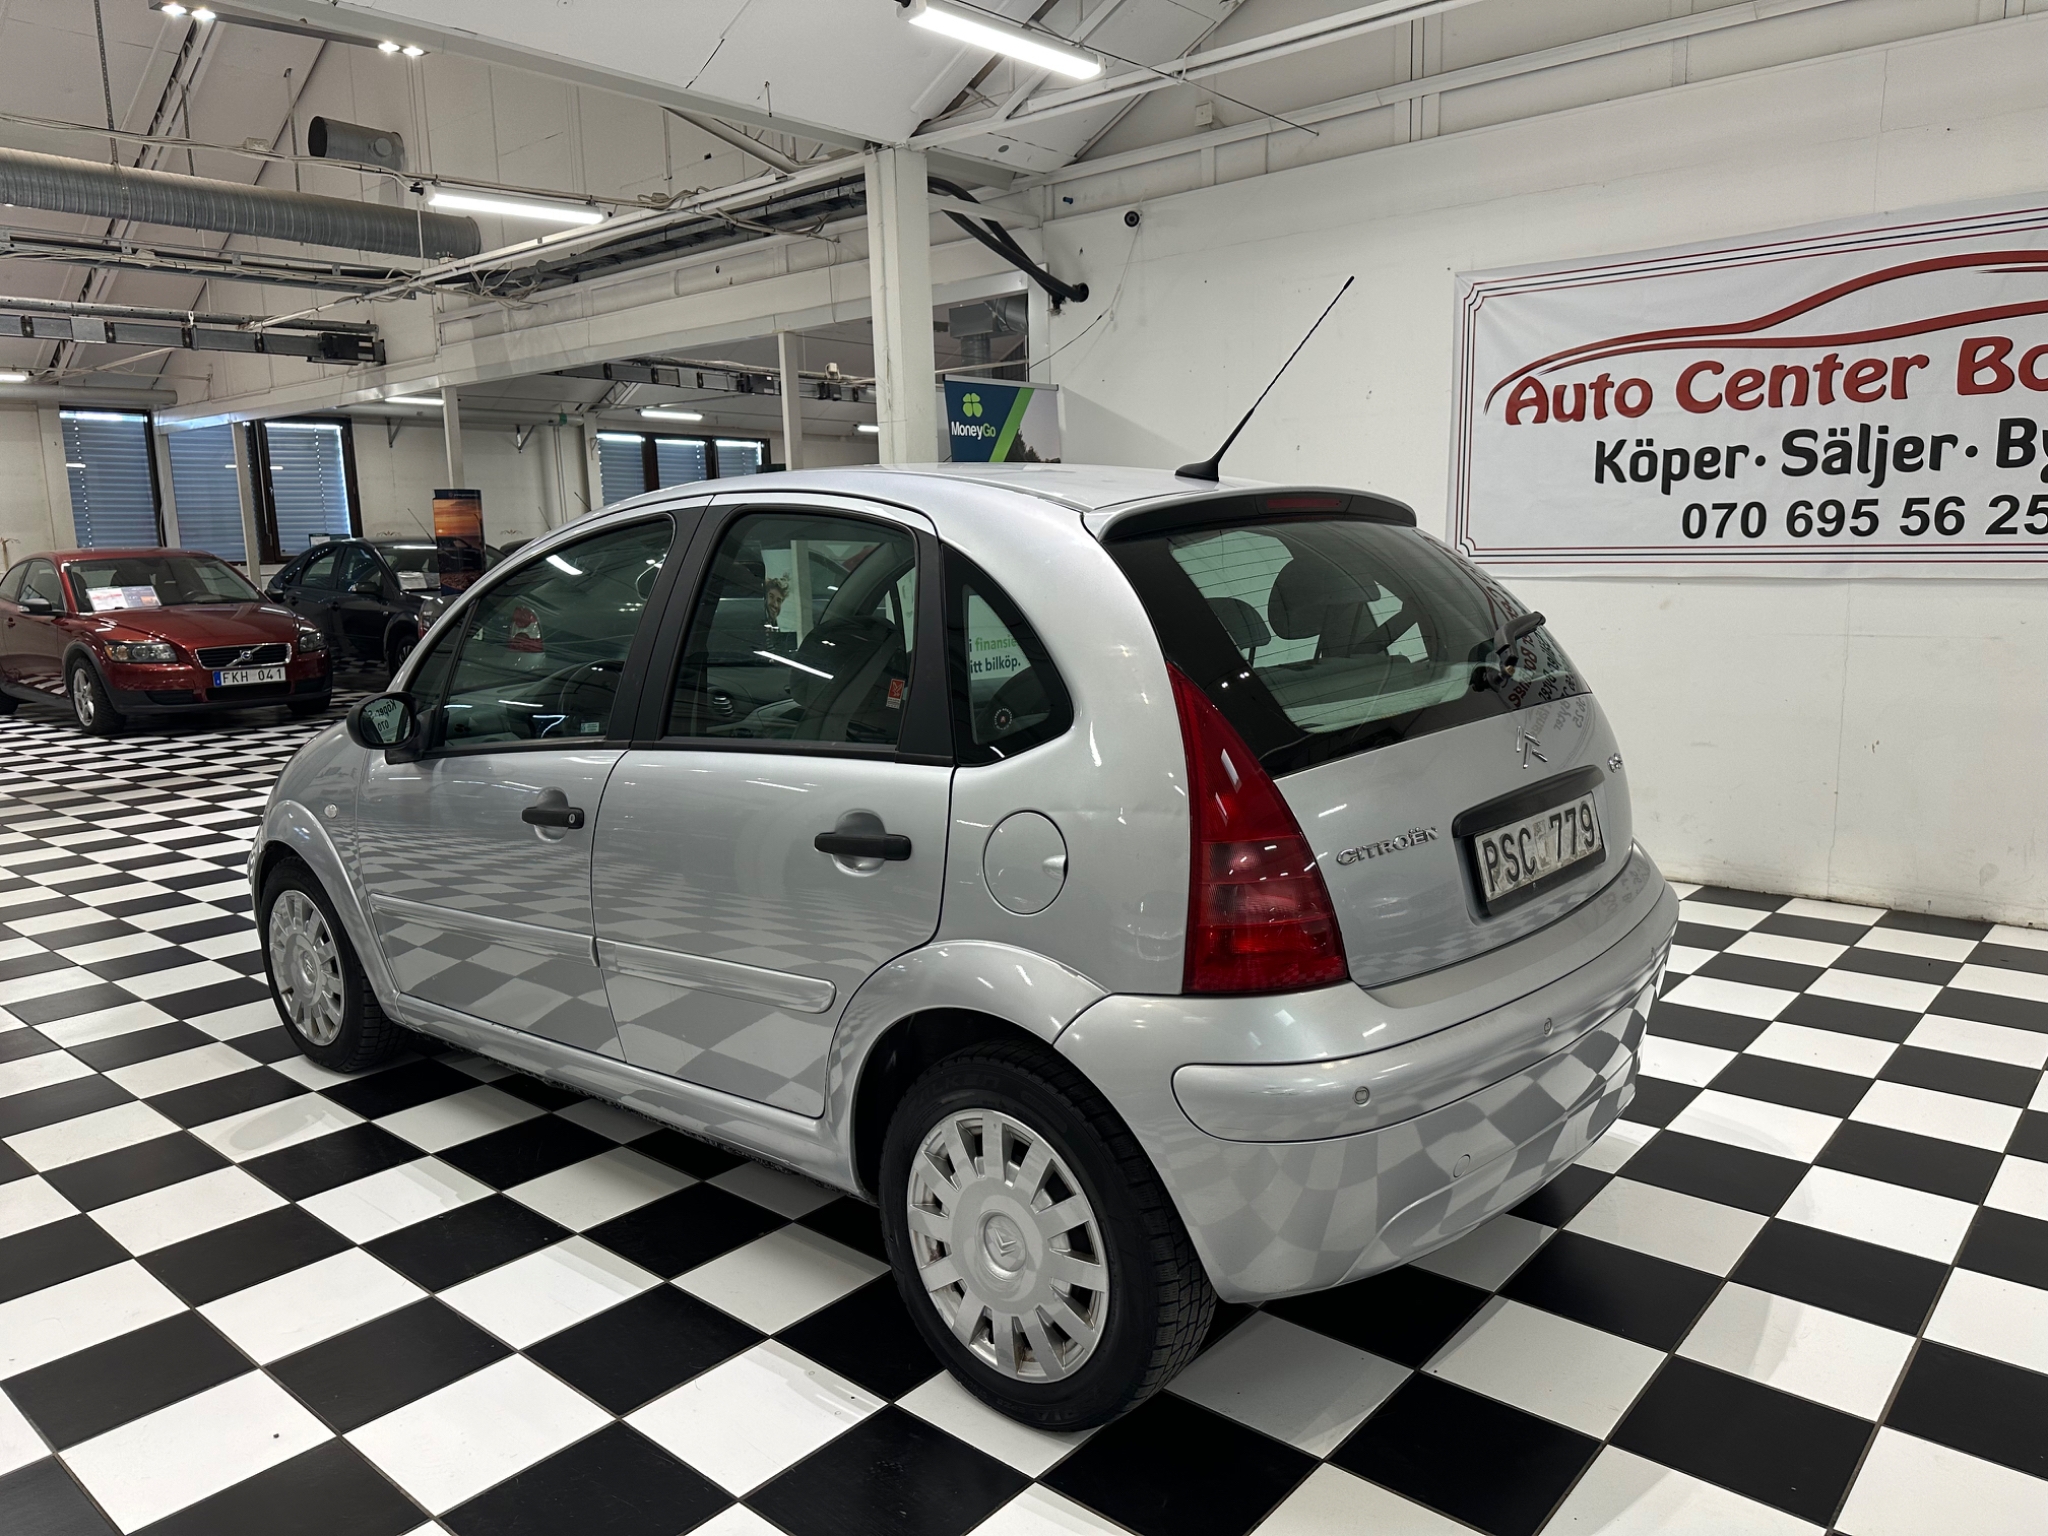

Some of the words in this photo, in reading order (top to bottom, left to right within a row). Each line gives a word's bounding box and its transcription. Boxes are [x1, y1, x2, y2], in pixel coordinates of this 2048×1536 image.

[1505, 373, 1653, 425] Auto
[1675, 353, 1930, 414] Center
[951, 421, 996, 440] MoneyGo
[1996, 417, 2048, 484] B
[1682, 502, 1767, 538] 070
[1785, 498, 1880, 537] 695
[1899, 496, 1966, 537] 56
[1985, 494, 2048, 535] 25
[974, 634, 1018, 652] finansie
[222, 671, 248, 684] FKH
[258, 668, 282, 681] 041
[970, 660, 983, 674] itt
[984, 655, 1021, 672] bilköp.
[1336, 826, 1440, 866] CITROËN
[1482, 826, 1536, 893] PSC
[1549, 801, 1596, 862] 779
